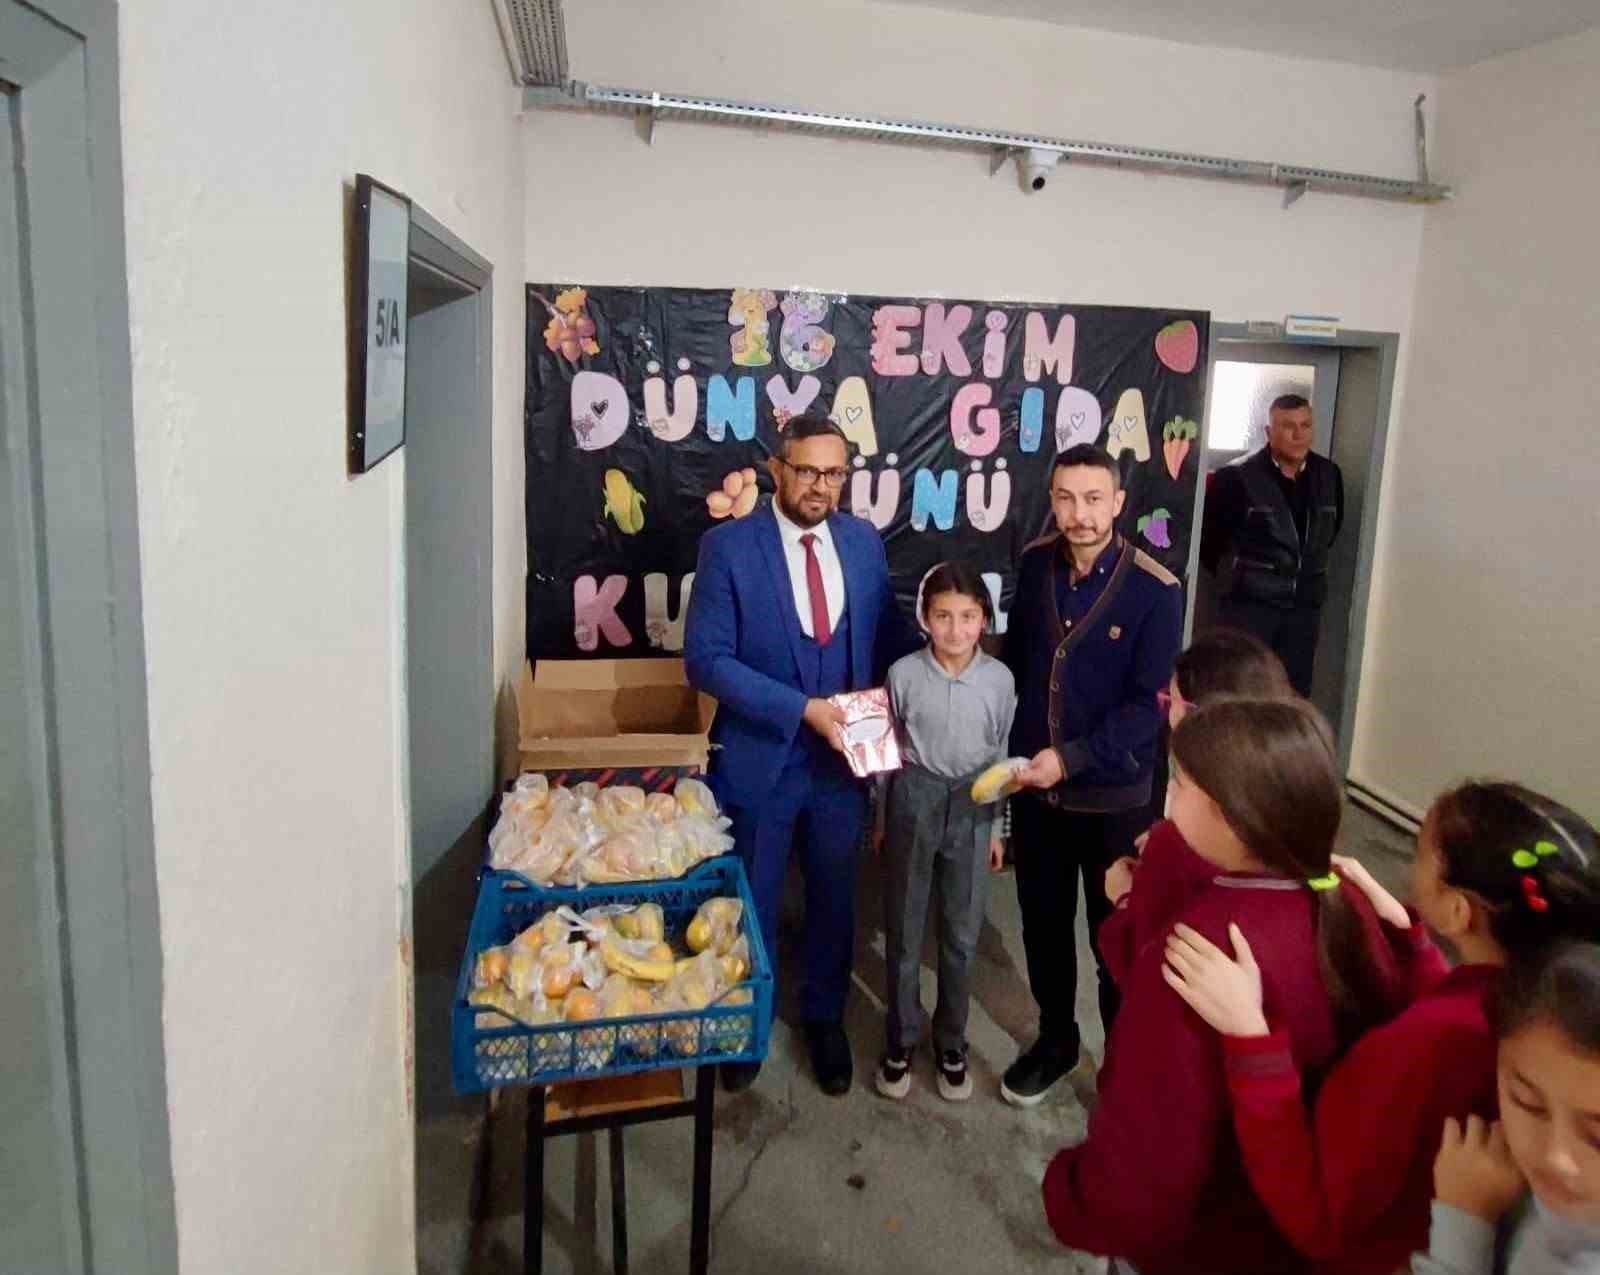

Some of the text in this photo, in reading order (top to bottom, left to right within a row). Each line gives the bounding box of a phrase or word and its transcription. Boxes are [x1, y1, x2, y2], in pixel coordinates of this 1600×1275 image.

[375, 298, 400, 348] 5/A
[728, 288, 835, 372] 16
[570, 357, 1151, 462] DÜNYA GIDA
[850, 452, 1011, 532] ÜNÜ
